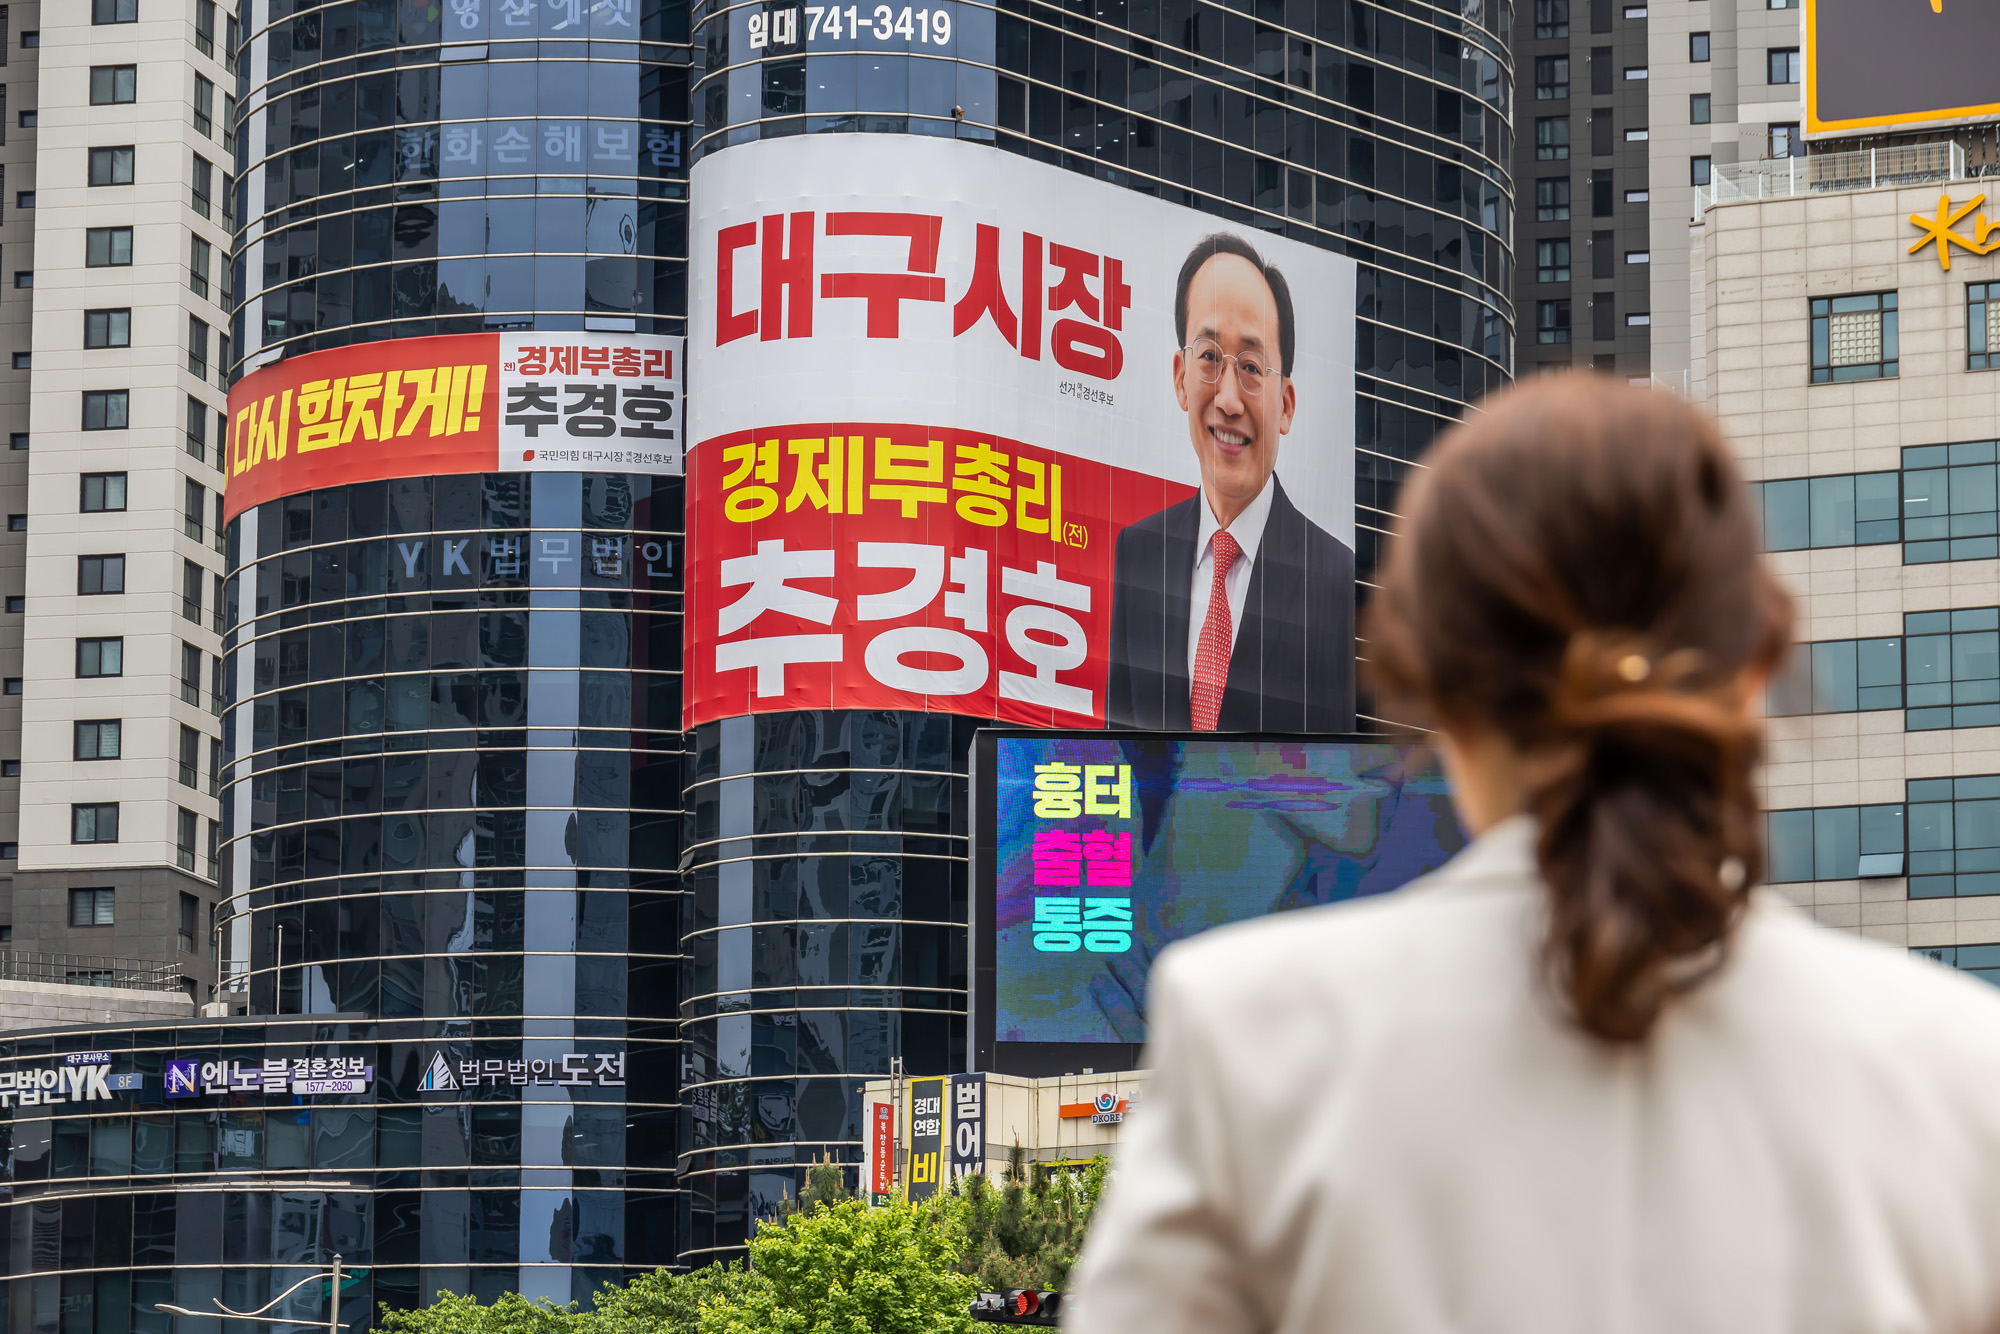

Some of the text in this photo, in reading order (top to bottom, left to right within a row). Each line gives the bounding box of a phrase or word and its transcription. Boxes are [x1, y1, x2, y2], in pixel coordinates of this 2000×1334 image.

[748, 5, 952, 49] 임대 741-3419
[401, 125, 681, 169] 한화손해보험
[716, 211, 1131, 381] 대구시장
[233, 388, 294, 478] 다시
[297, 364, 488, 453] 힘차게!
[504, 382, 675, 440] 추경호
[538, 450, 580, 462] 국민의힘
[582, 451, 624, 463] 대구시장
[715, 539, 1094, 716] 추경호
[1032, 761, 1132, 819] 흉터
[1032, 829, 1132, 887] 출혈
[1032, 896, 1133, 954] 통증
[118, 1075, 132, 1088] 8F
[201, 1057, 366, 1095] 엔노블 결혼정보
[305, 1080, 353, 1092] 1577-2050
[459, 1052, 626, 1087] 법무법인 도전
[913, 1118, 941, 1137] 연합
[914, 1096, 940, 1115] 경대
[1092, 1113, 1120, 1124] DKORE
